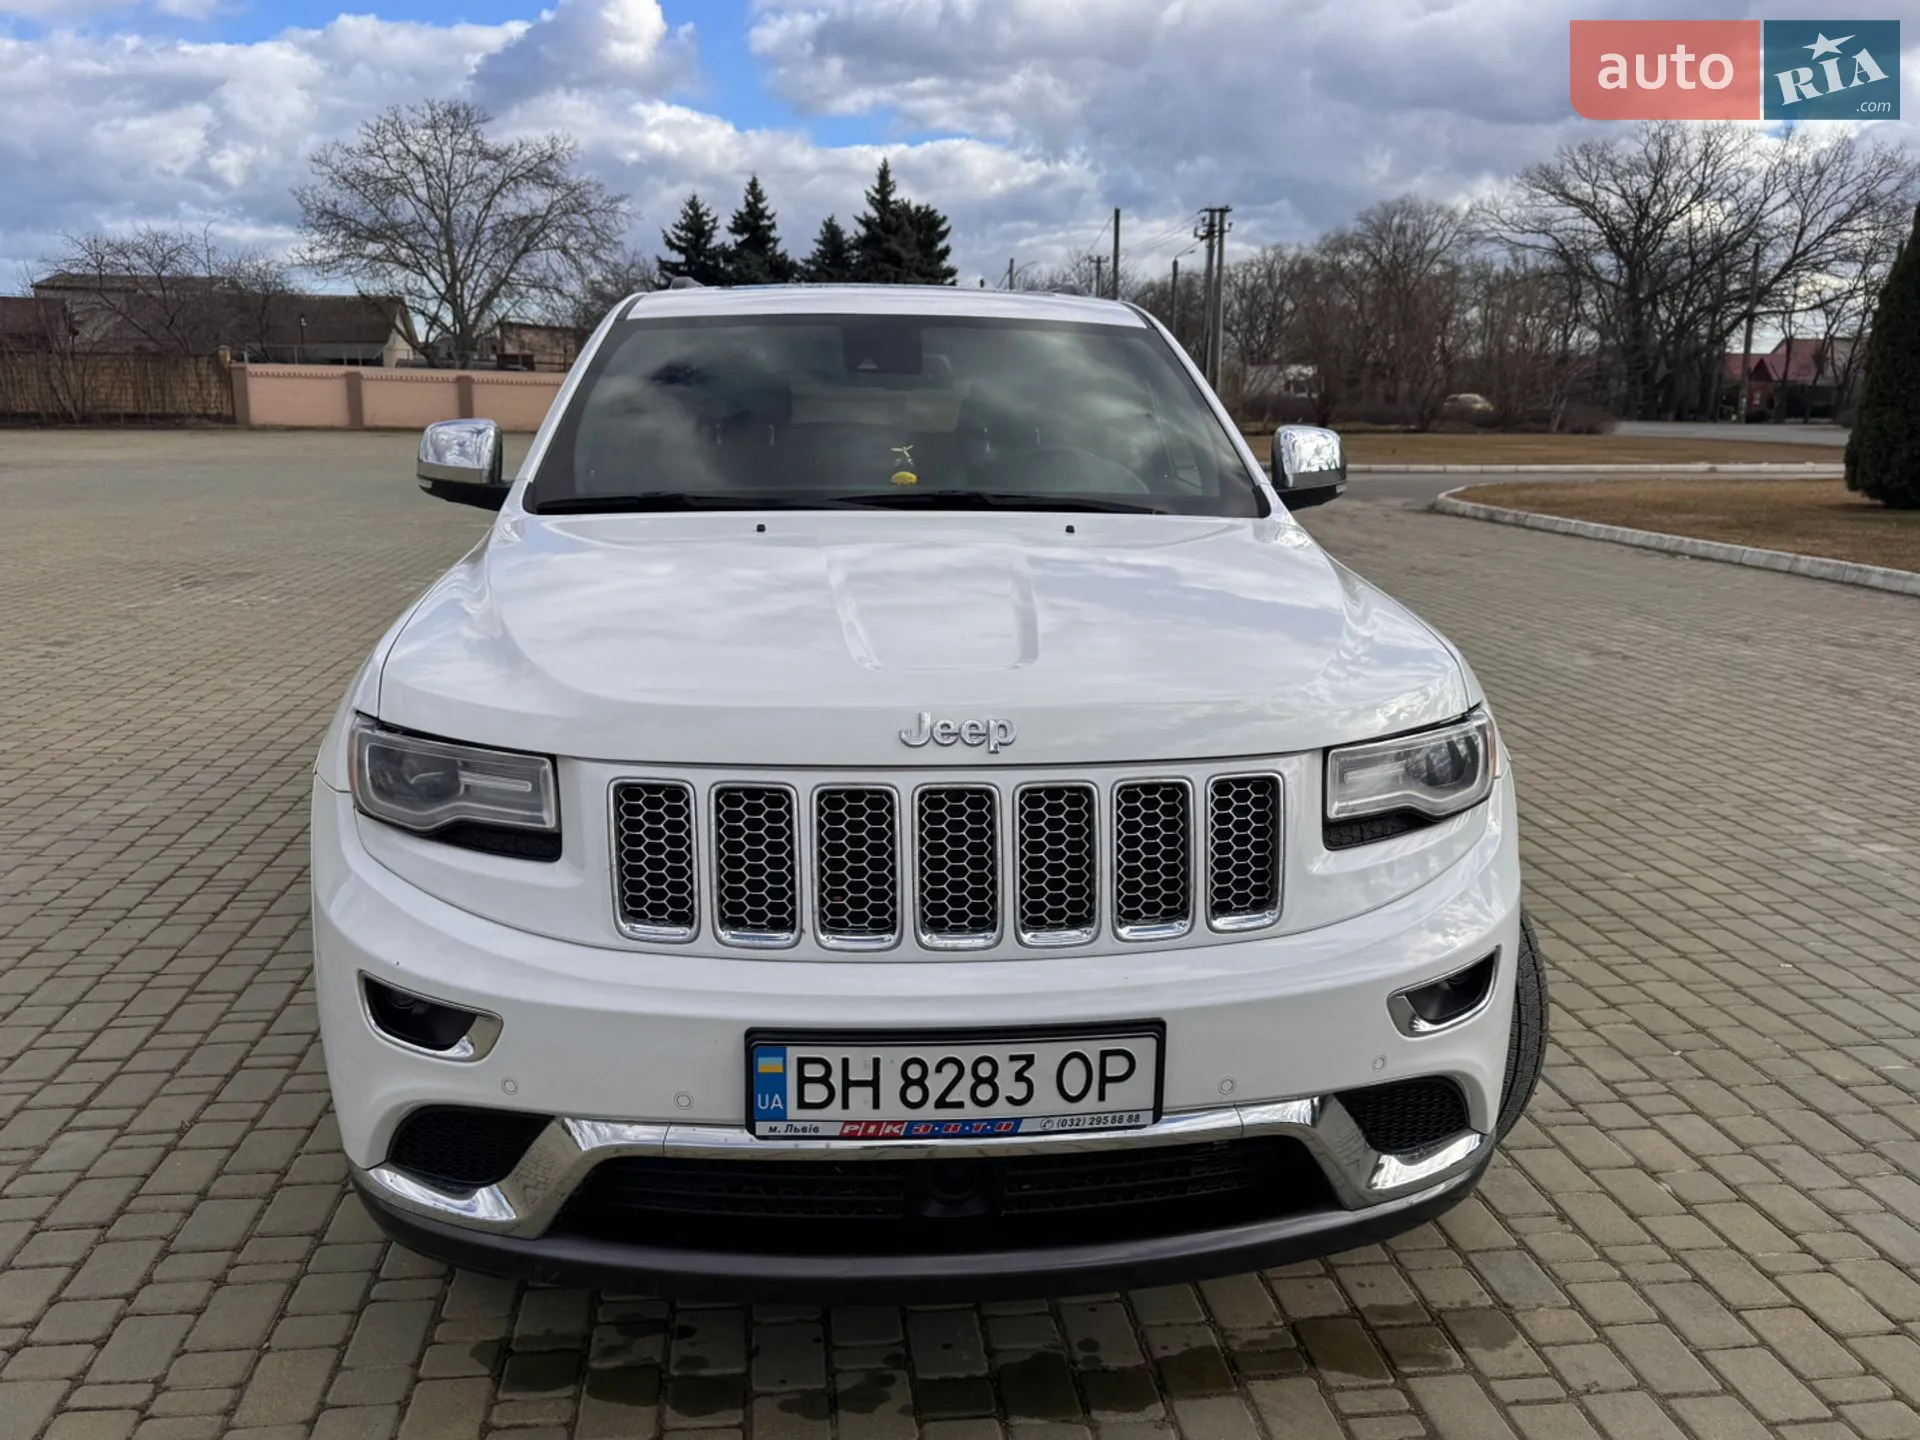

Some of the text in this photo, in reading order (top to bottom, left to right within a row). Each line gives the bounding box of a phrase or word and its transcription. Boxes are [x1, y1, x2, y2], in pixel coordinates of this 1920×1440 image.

[899, 711, 1017, 754] Jeep
[796, 1047, 1137, 1110] BH 8283 OP
[757, 1093, 784, 1110] UA
[1057, 1117, 1086, 1129] (032)
